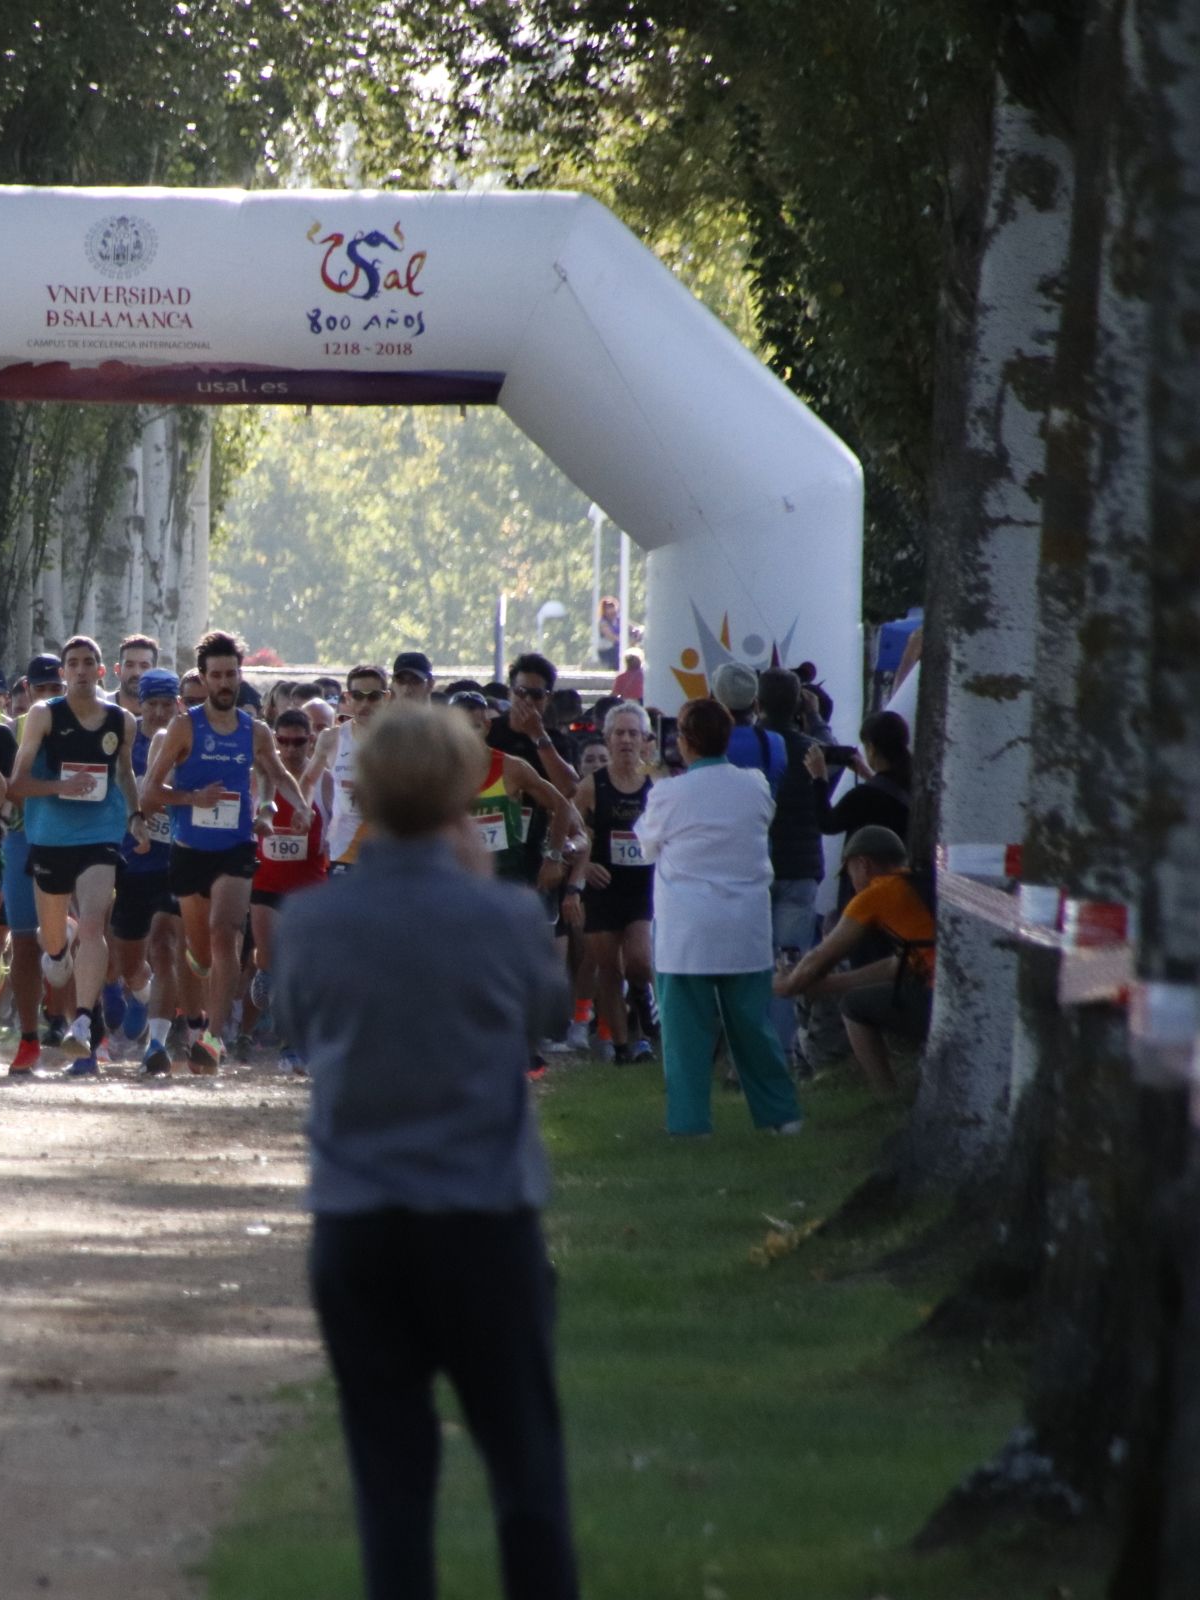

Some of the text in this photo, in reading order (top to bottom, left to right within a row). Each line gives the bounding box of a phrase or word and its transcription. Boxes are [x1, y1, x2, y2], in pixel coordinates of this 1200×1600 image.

[63, 309, 193, 329] SALAMANCA
[307, 308, 351, 334] 800
[27, 339, 211, 351] CAMPUS DE EXCELENCIA INTERNACIONAL
[324, 343, 360, 355] 1218
[376, 343, 412, 355] 2018
[197, 378, 288, 393] usal.es
[213, 807, 220, 820] 1
[270, 841, 300, 855] 190
